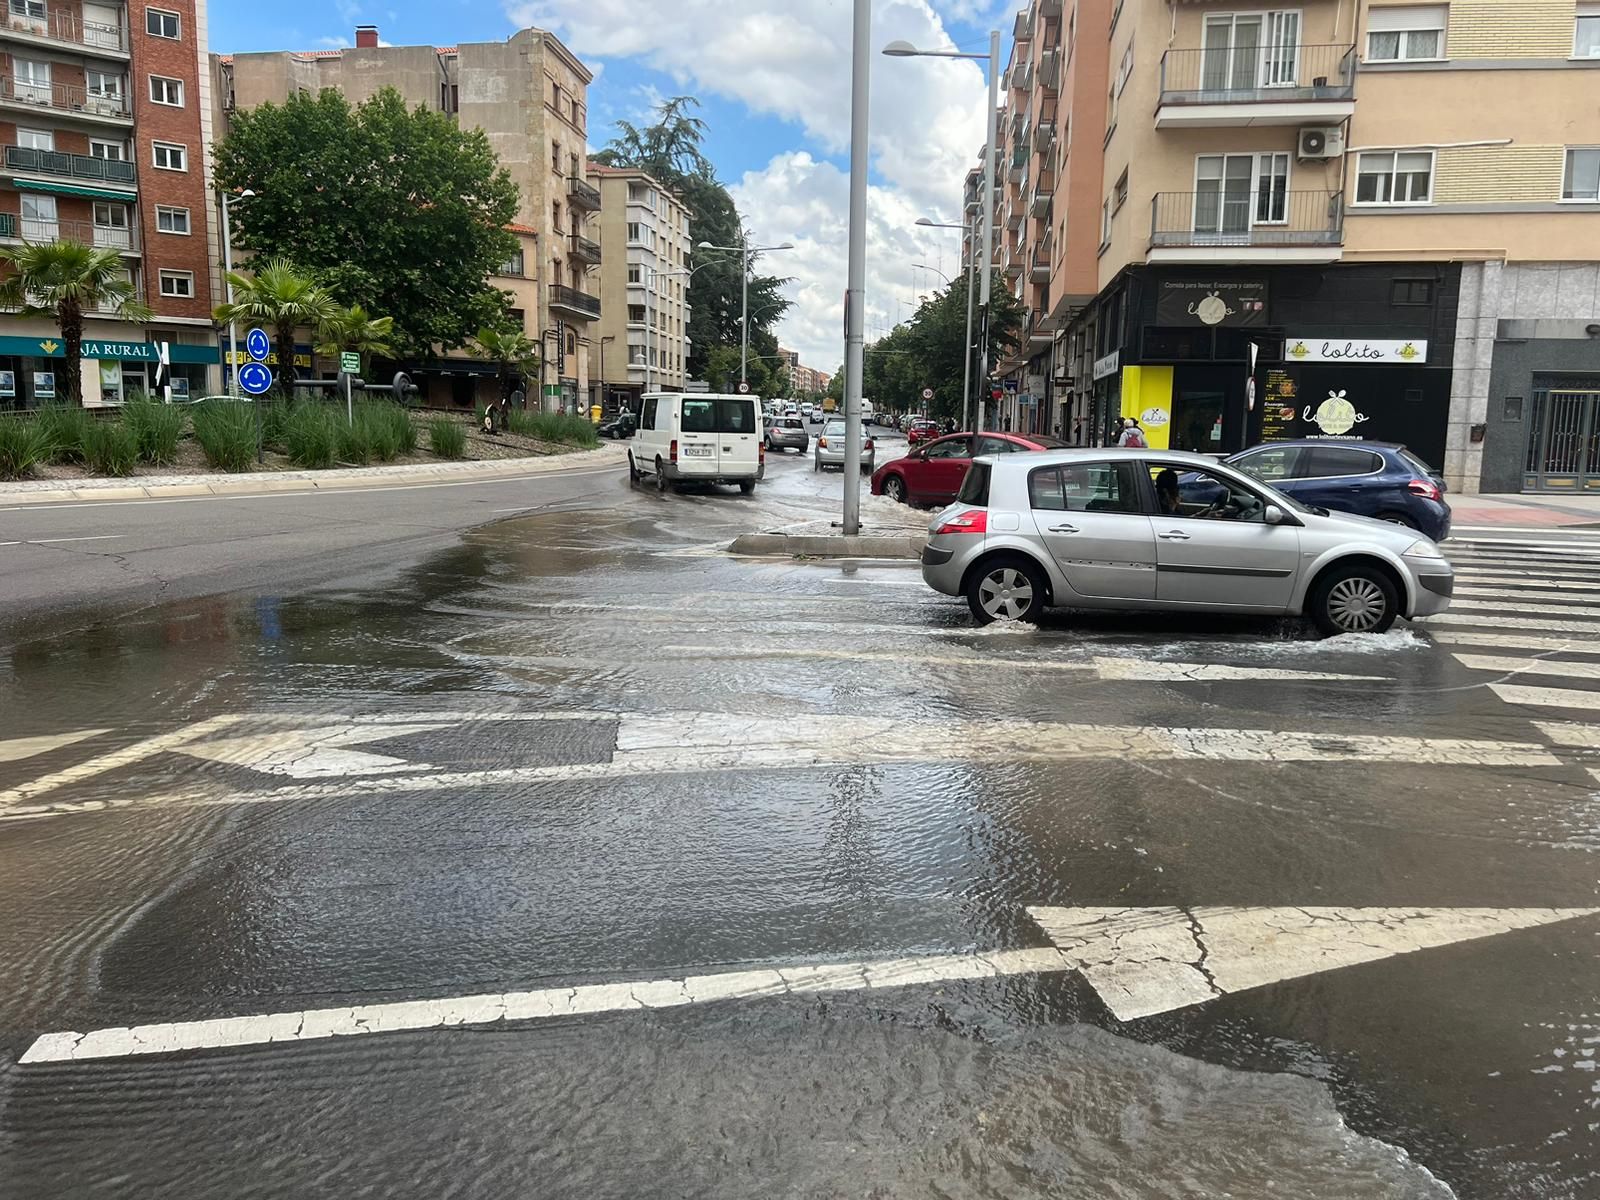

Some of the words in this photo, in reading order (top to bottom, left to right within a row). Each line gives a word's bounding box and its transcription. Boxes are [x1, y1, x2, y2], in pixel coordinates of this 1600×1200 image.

[104, 344, 149, 357] RURAL
[1321, 341, 1384, 360] lolito
[1141, 414, 1168, 422] lolito
